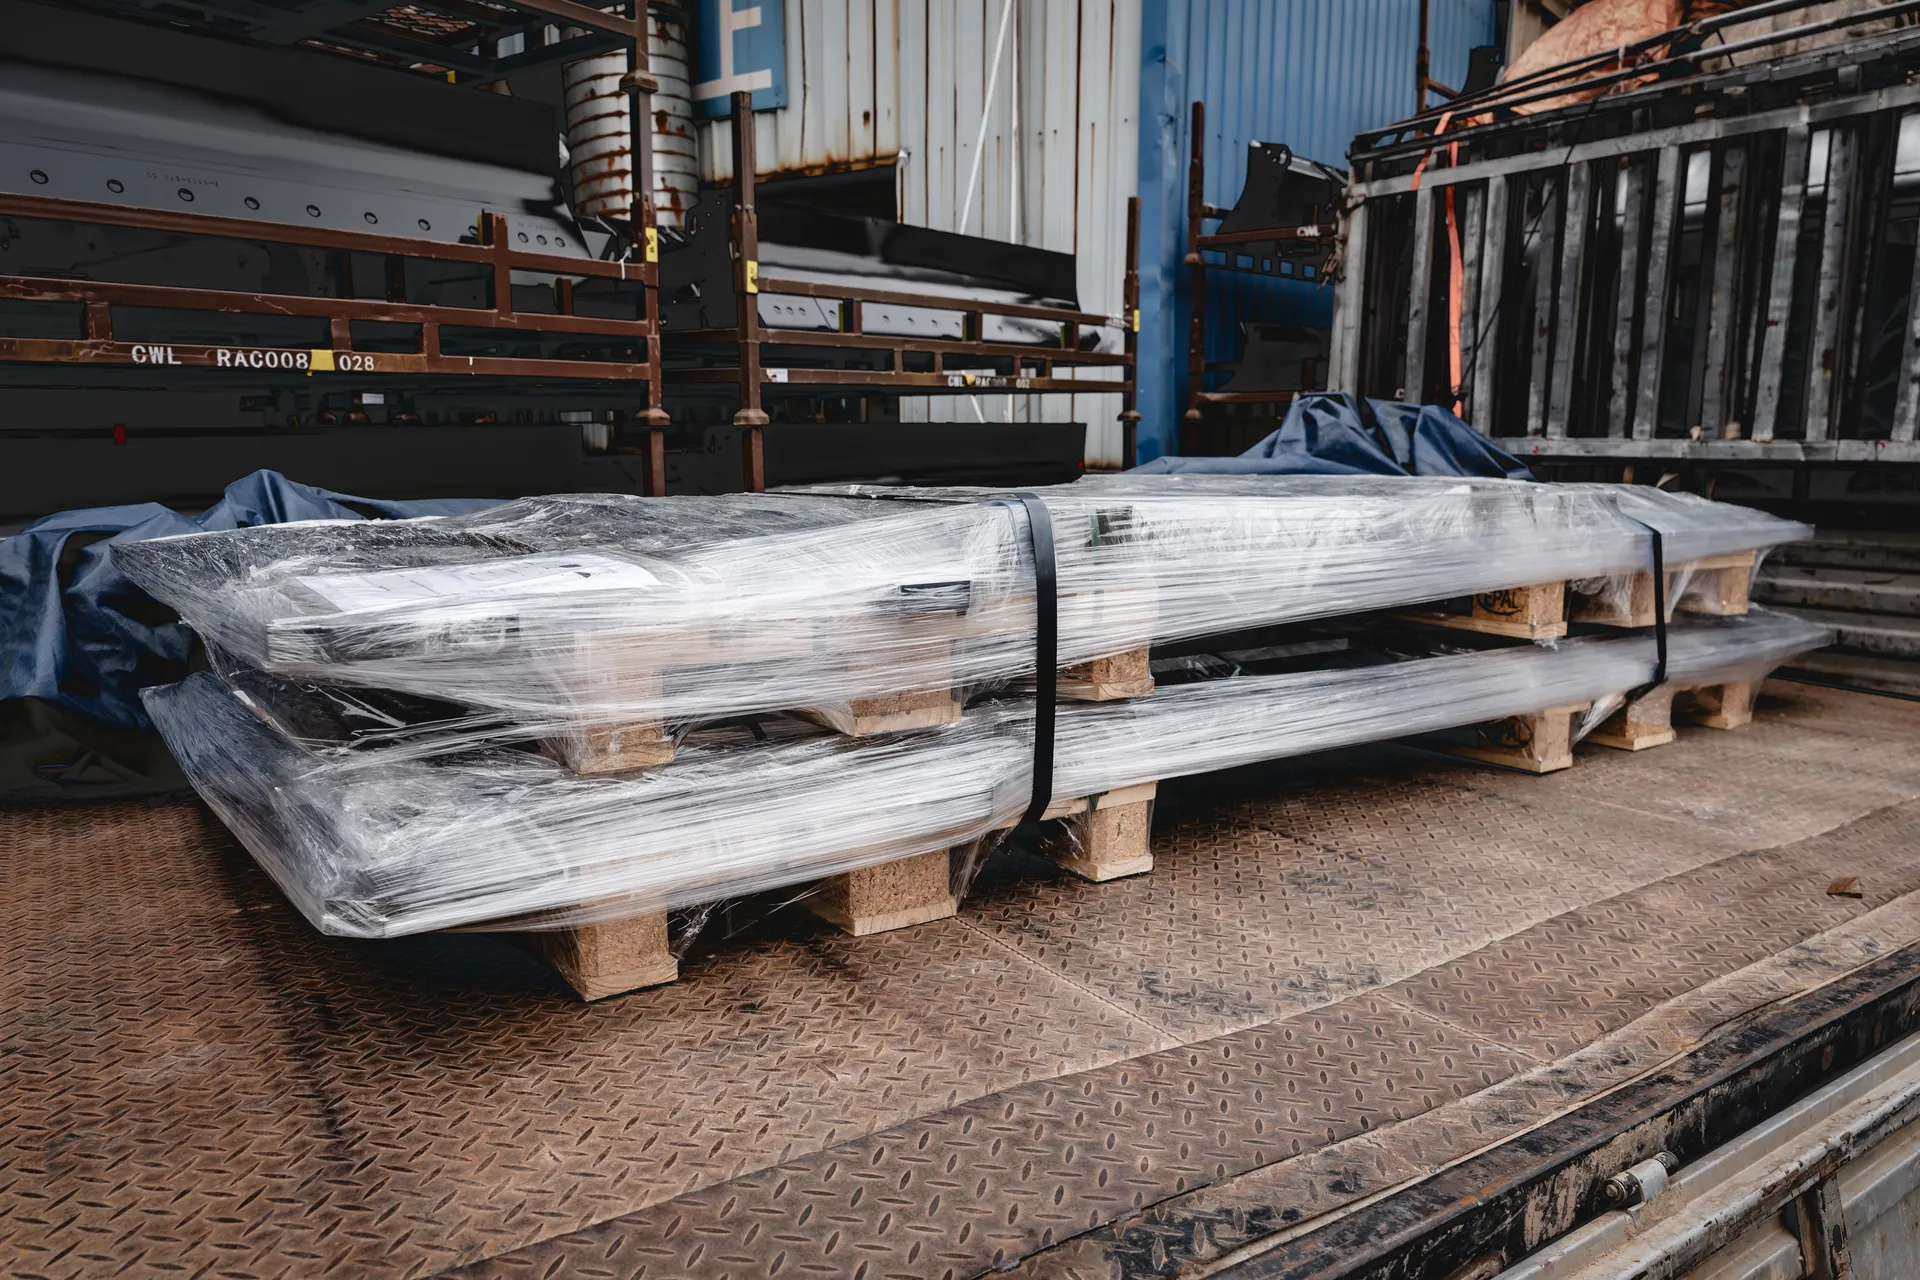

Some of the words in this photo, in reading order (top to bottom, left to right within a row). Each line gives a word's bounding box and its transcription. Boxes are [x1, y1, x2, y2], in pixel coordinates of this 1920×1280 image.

[131, 345, 182, 365] CWL
[217, 349, 309, 369] RAC008
[339, 355, 375, 371] 028
